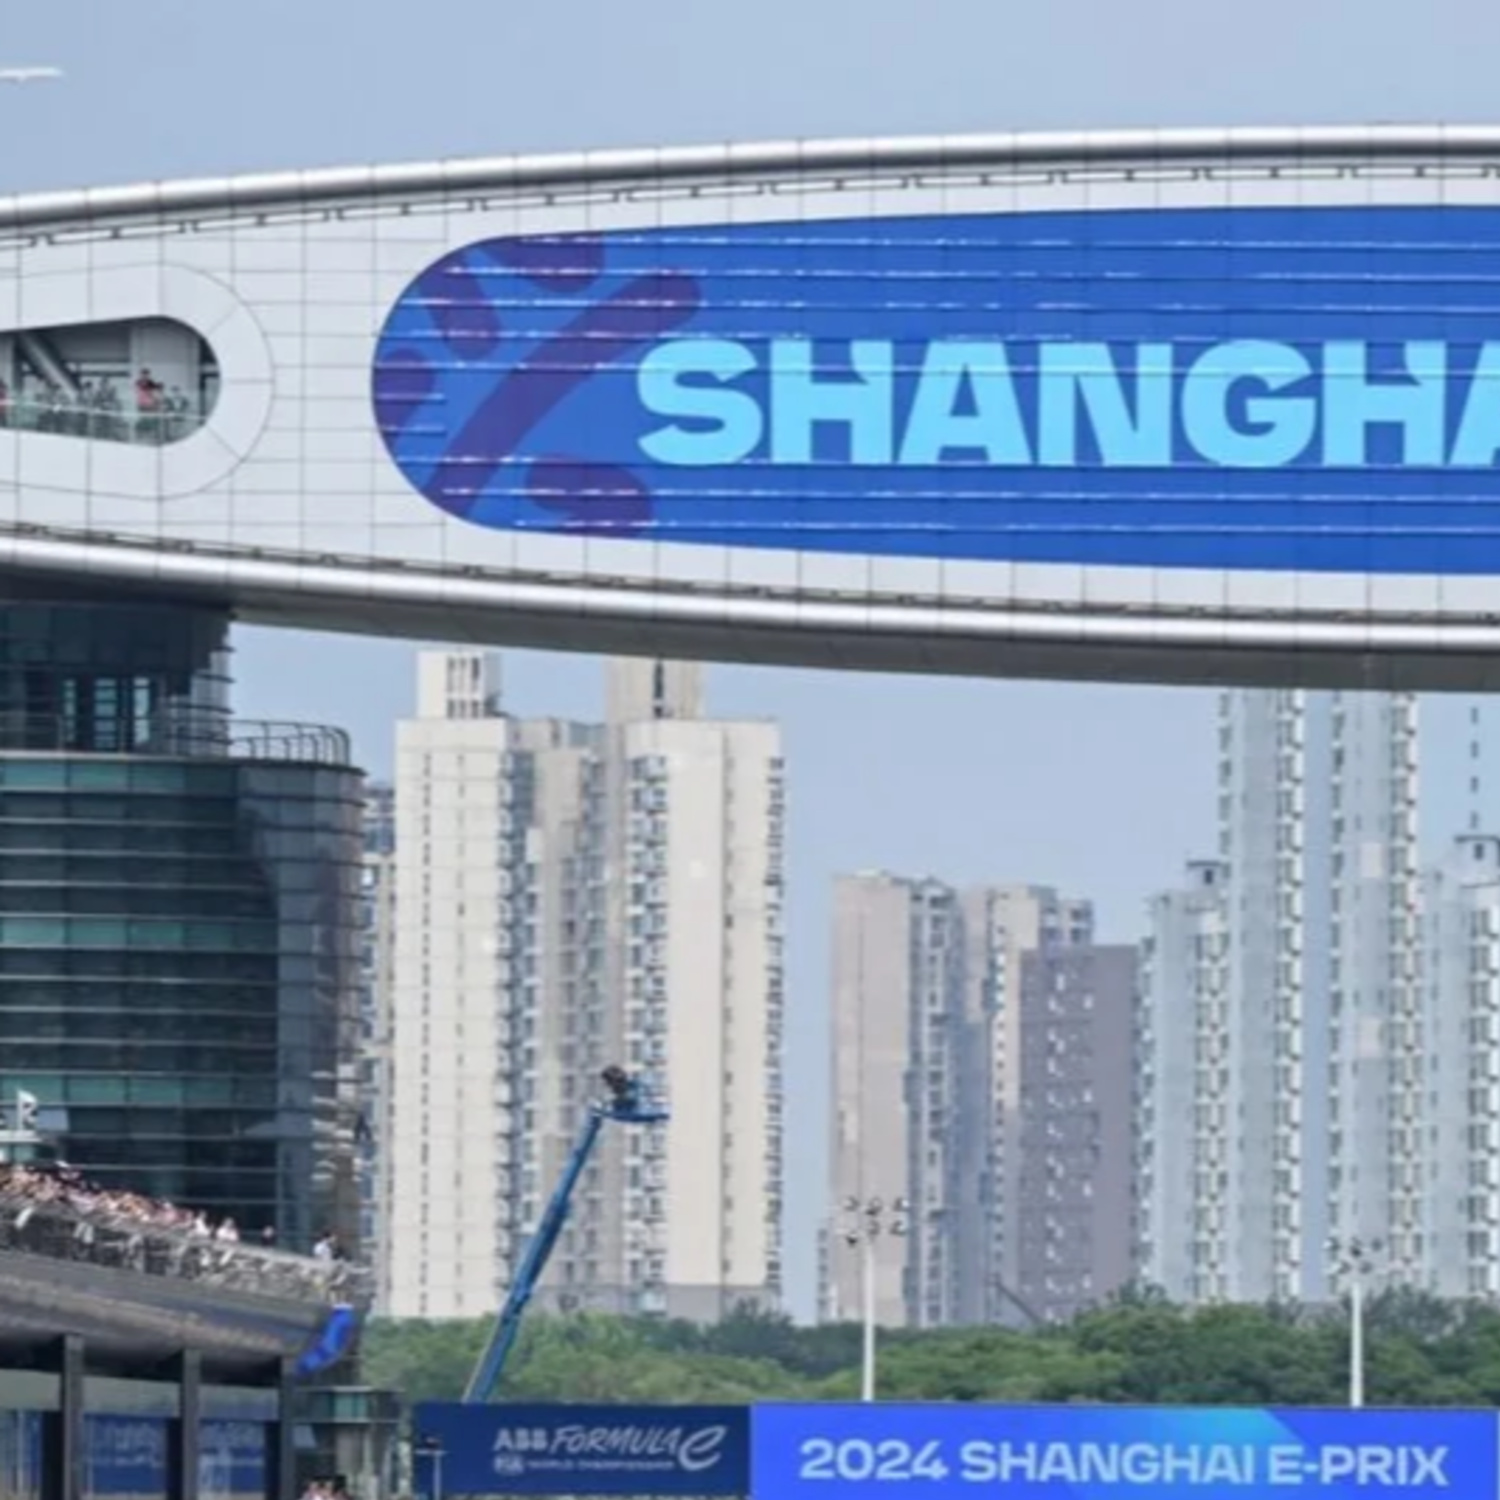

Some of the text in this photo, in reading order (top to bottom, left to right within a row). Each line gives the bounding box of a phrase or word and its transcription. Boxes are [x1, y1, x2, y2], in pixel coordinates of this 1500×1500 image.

[494, 1428, 548, 1451] ABB
[551, 1425, 683, 1455] FORMULA
[800, 1438, 1449, 1486] 2024 SHANGHAI E-PRIX
